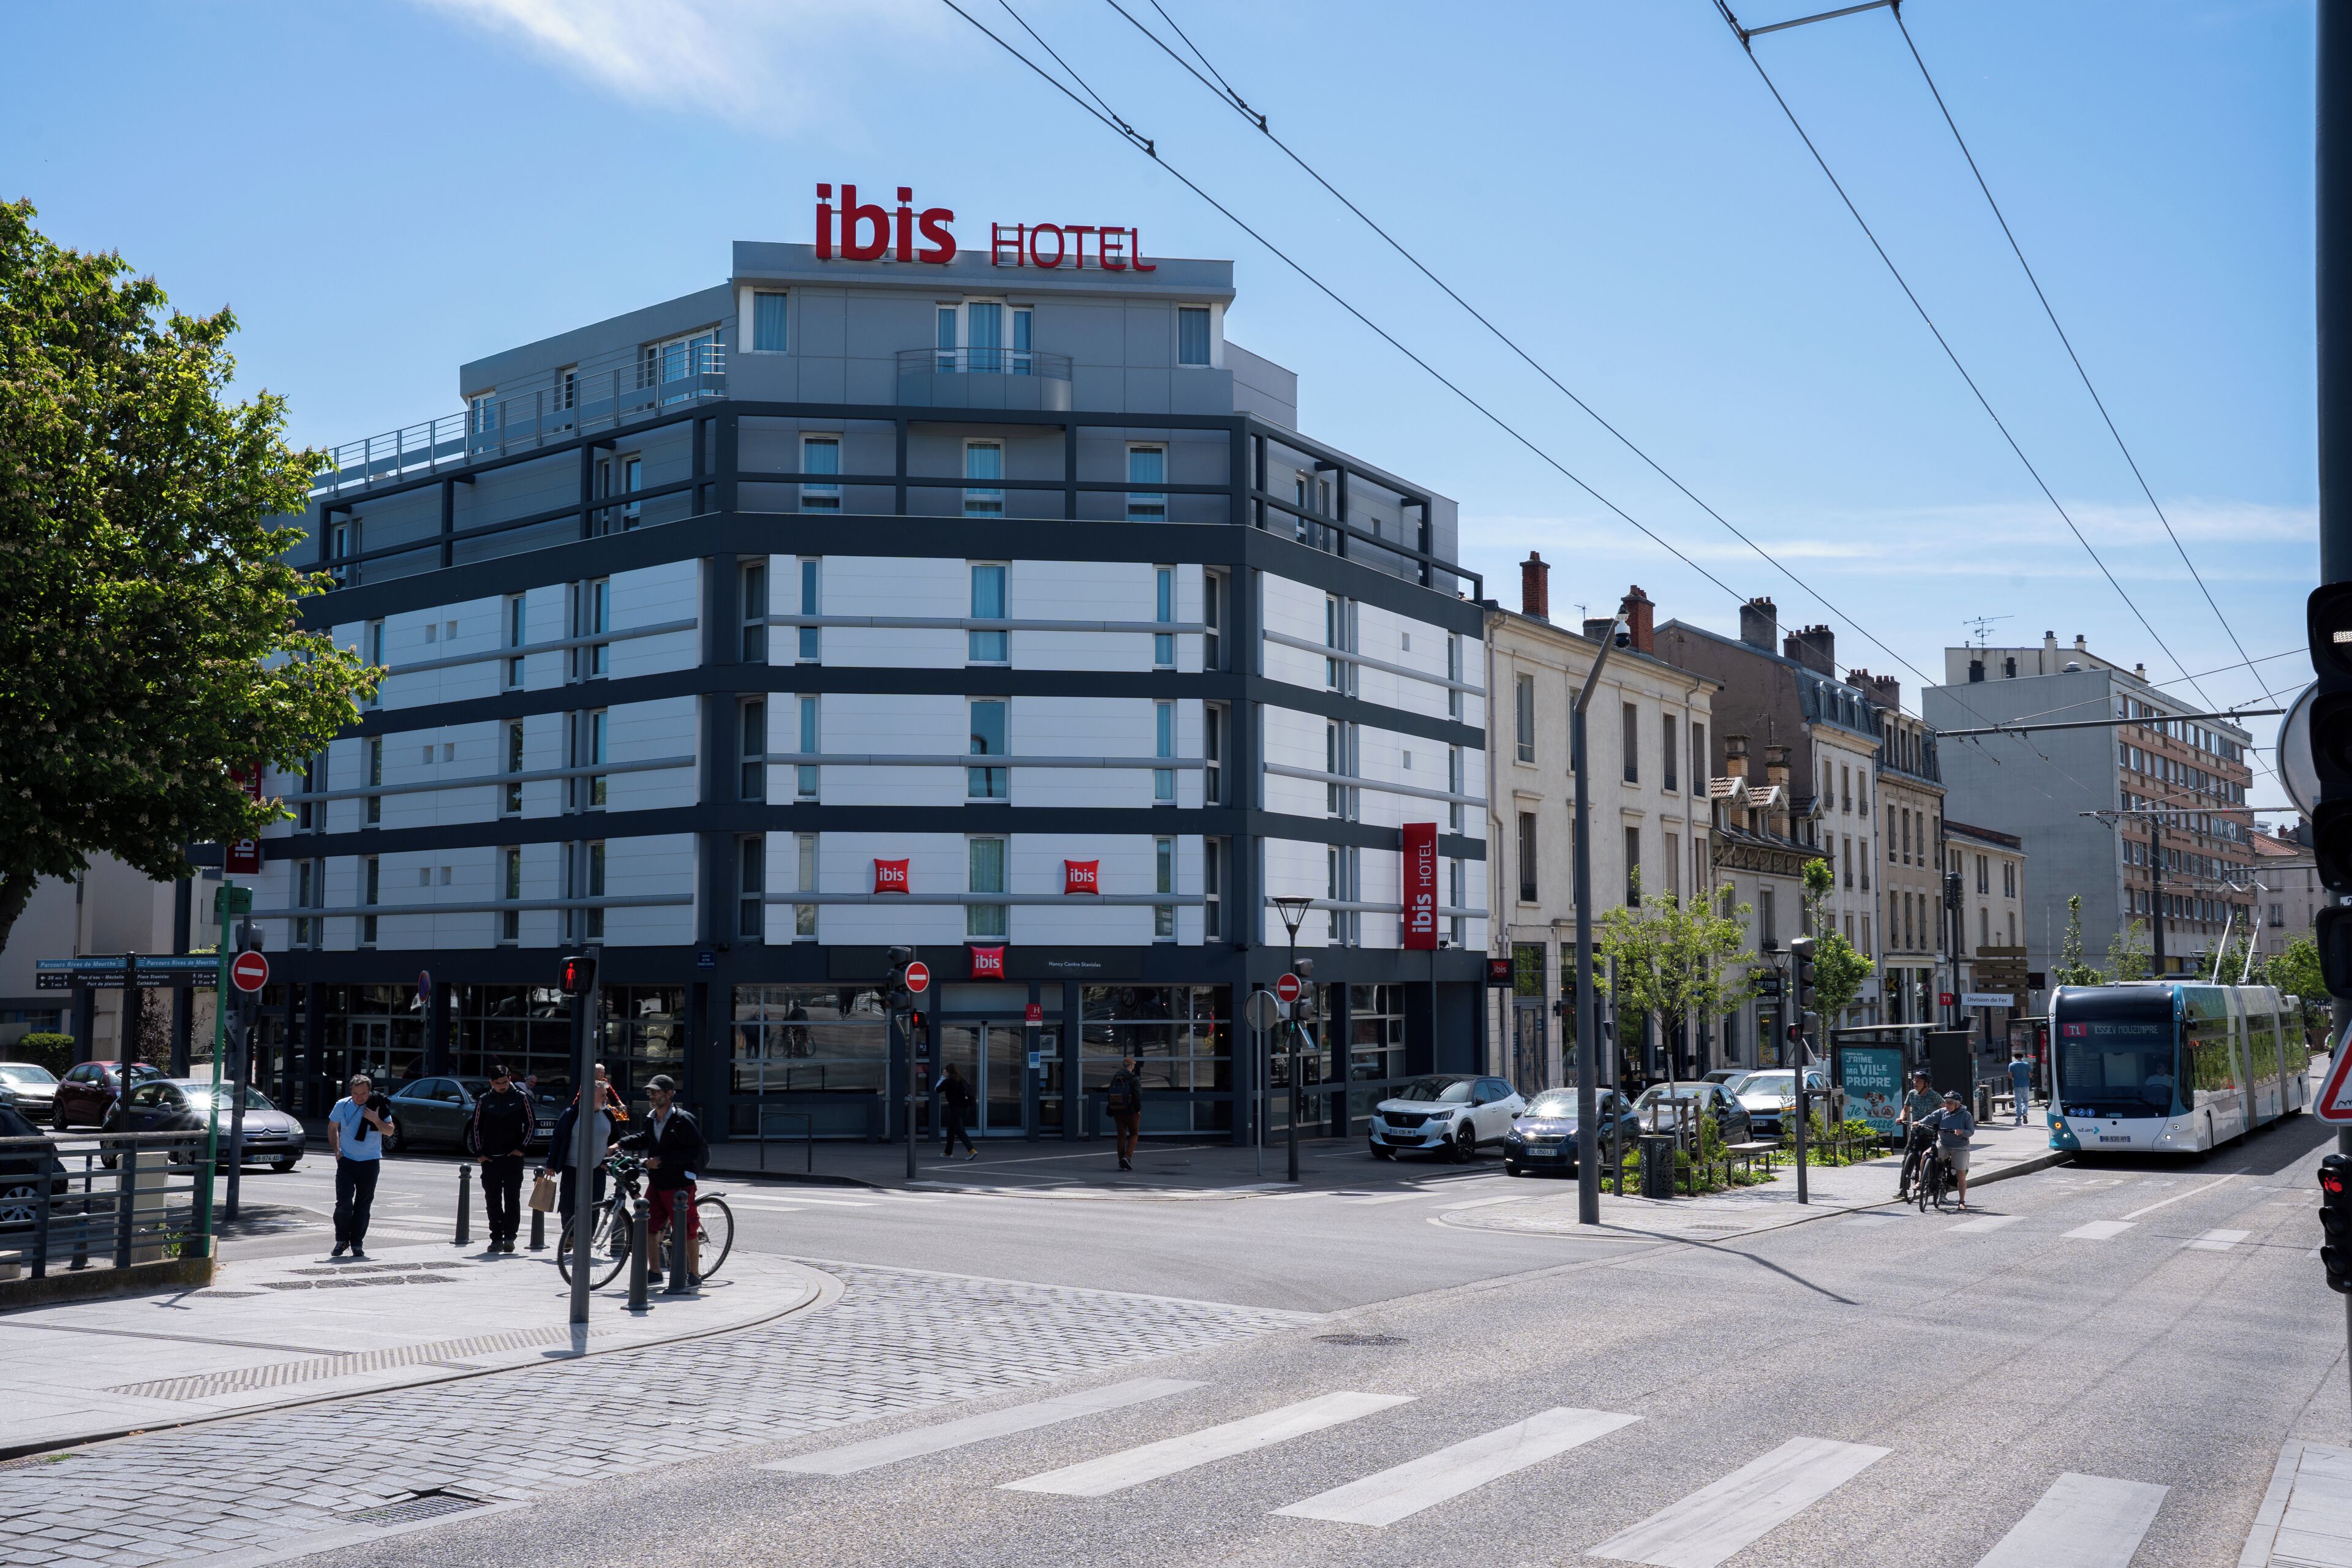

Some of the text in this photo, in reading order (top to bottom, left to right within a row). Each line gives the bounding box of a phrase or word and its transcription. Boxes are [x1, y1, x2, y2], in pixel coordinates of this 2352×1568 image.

[816, 183, 1156, 271] ibis HOTEL
[1419, 840, 1431, 886] HOTEL
[880, 867, 904, 881] ibis
[1070, 868, 1095, 882] ibis
[1412, 893, 1431, 933] ibis
[975, 954, 1000, 968] ibis
[2069, 1025, 2158, 1035] T1 ESSEY MOUZIMPRE
[1860, 1064, 1888, 1076] VILLE
[1845, 1076, 1891, 1087] PROPRE
[1847, 1104, 1863, 1117] Je
